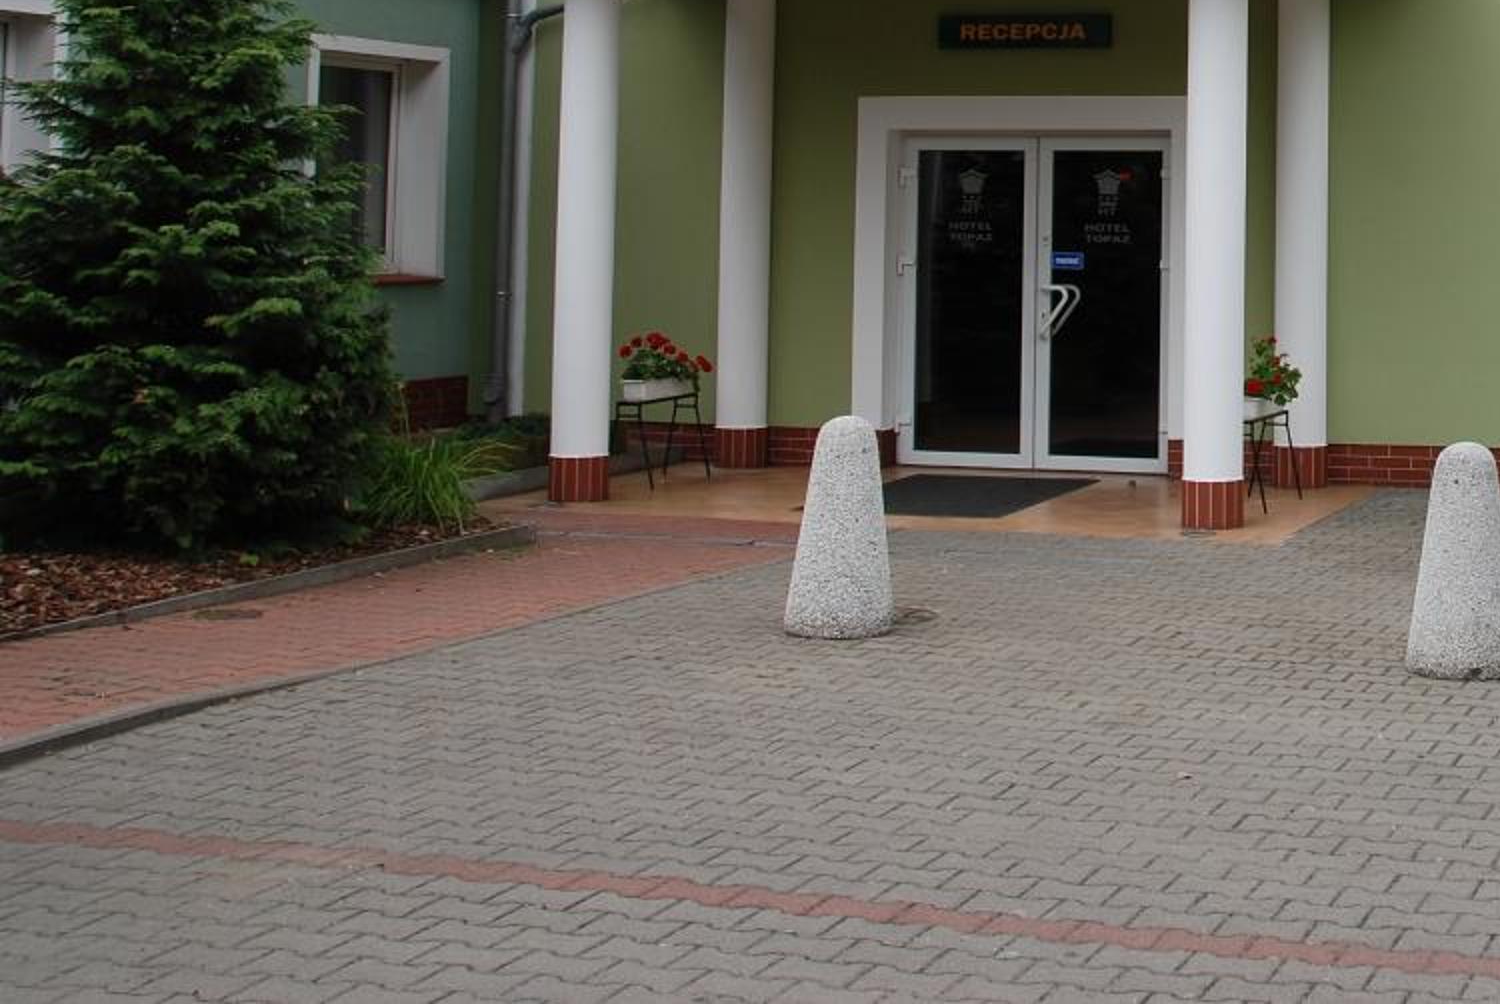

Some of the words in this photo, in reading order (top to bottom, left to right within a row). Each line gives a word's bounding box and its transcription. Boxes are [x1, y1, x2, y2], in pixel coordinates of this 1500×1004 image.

[960, 22, 1087, 41] RECEPCJA
[948, 221, 993, 231] HOTEL
[1084, 223, 1130, 233] HOTEL
